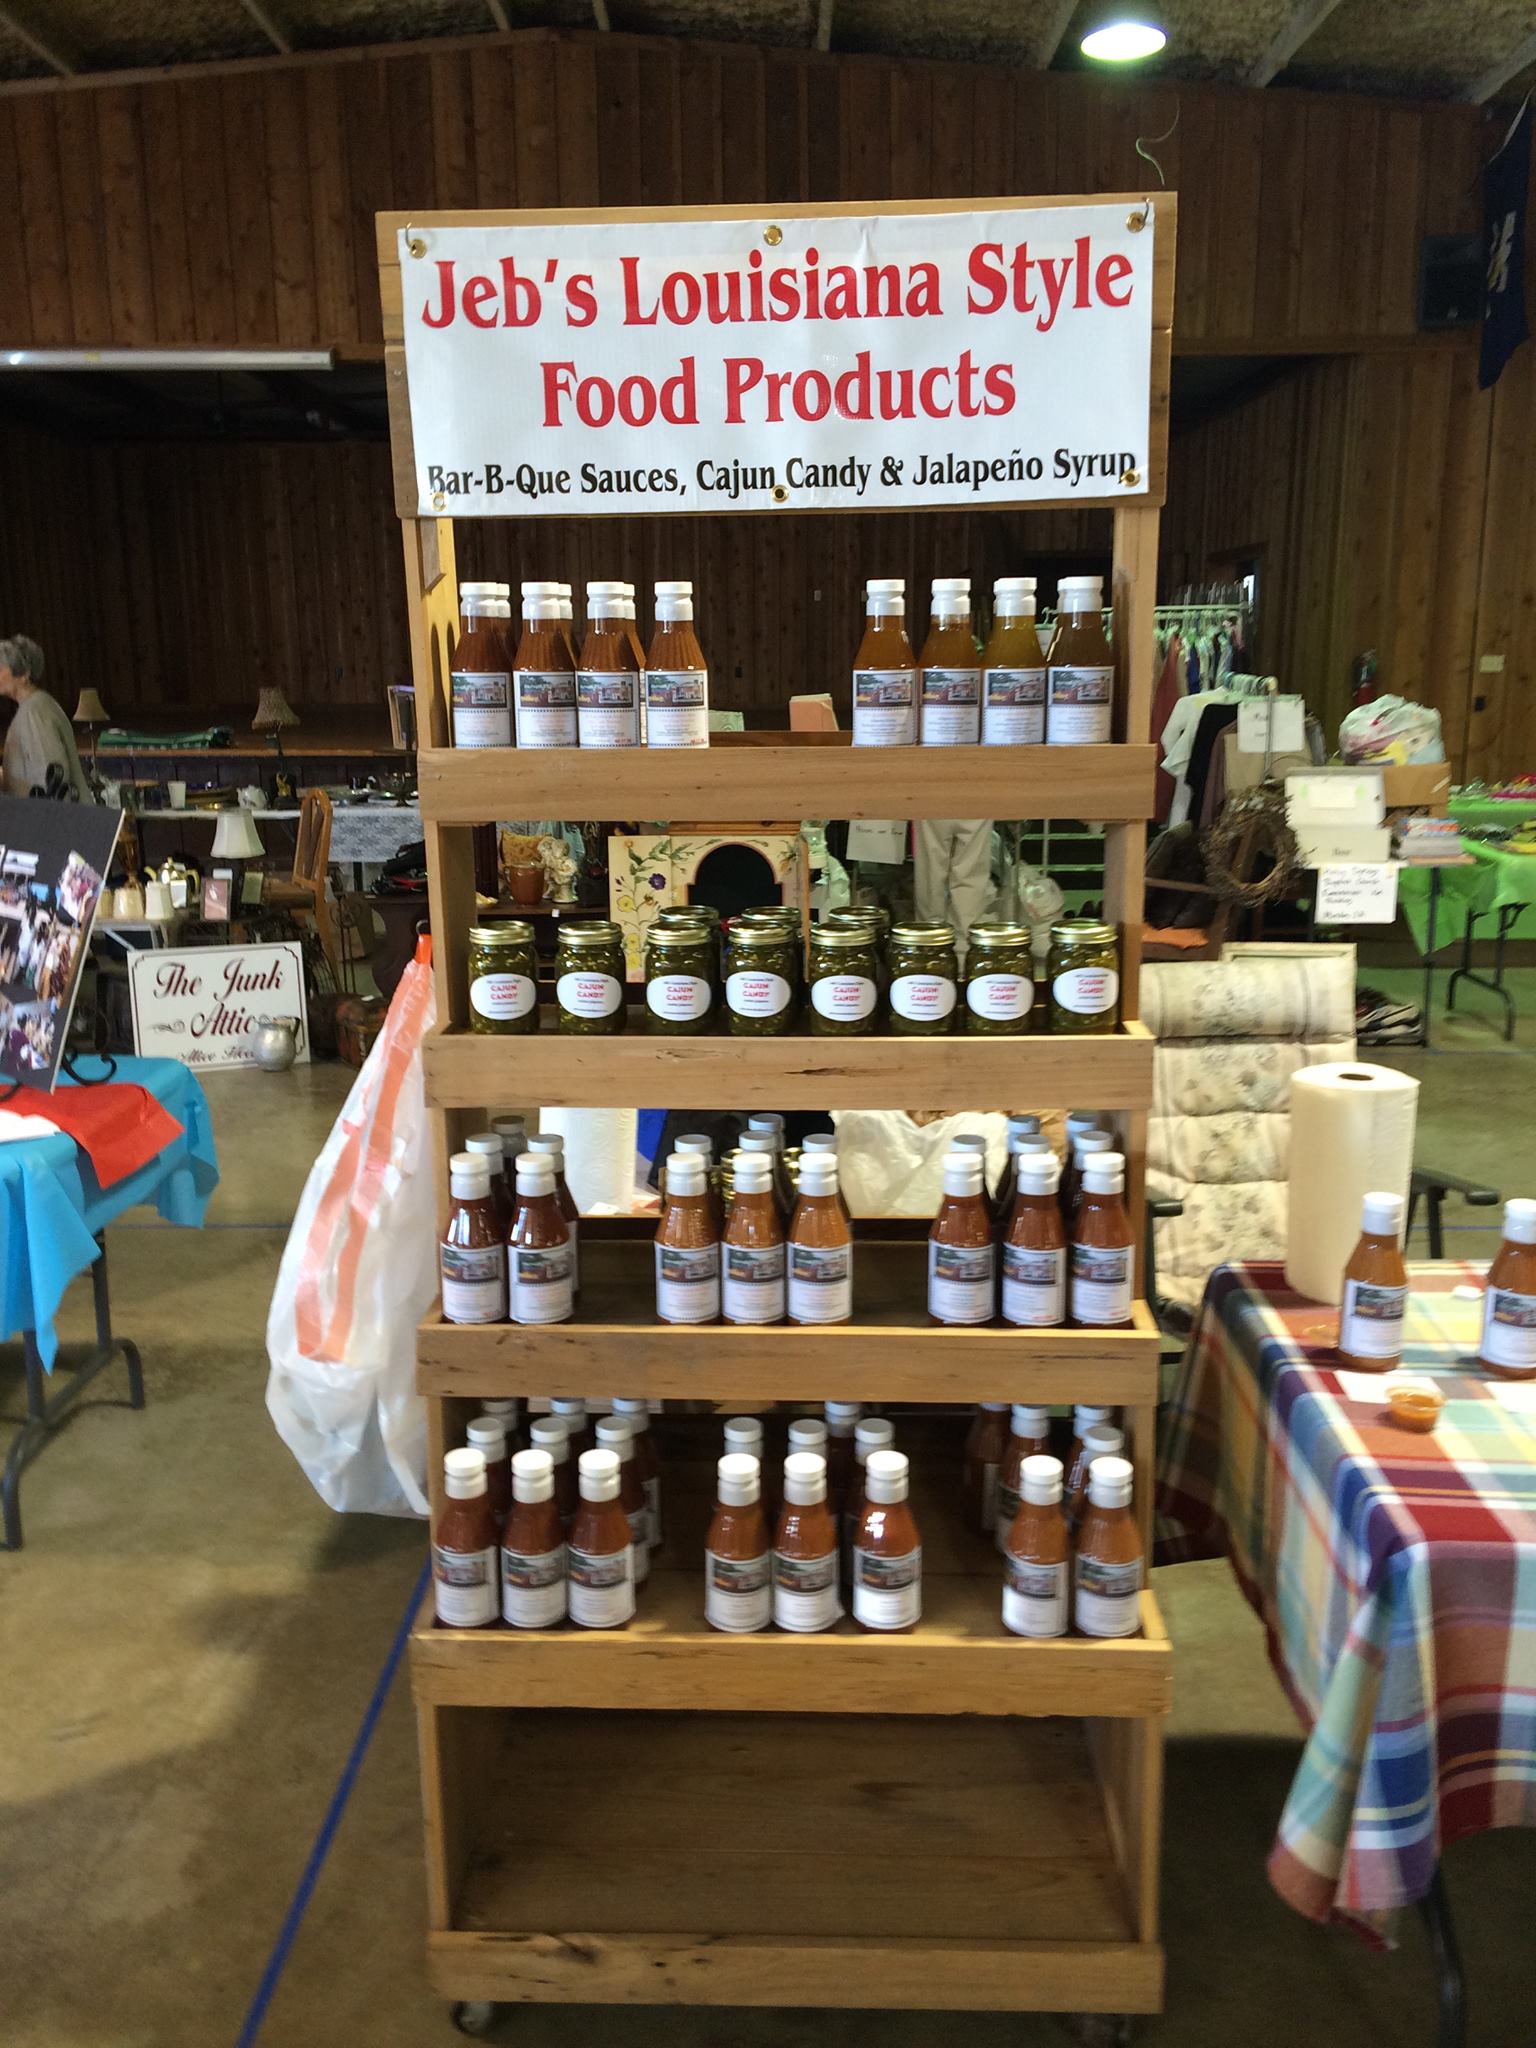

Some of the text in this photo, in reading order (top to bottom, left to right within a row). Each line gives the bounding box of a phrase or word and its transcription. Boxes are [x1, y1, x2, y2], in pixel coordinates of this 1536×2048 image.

[422, 234, 1135, 332] Jeb's Louisiana Style
[541, 349, 1016, 428] Food Products
[428, 447, 1136, 499] Bar-B-Que Sauces, Cajun Candy & Jalapeño Syrup
[153, 957, 284, 1002] The Junk
[490, 984, 517, 992] CAJUN
[490, 992, 518, 1000] CANDY
[576, 991, 605, 999] CANDY
[190, 1002, 256, 1039] Attic
